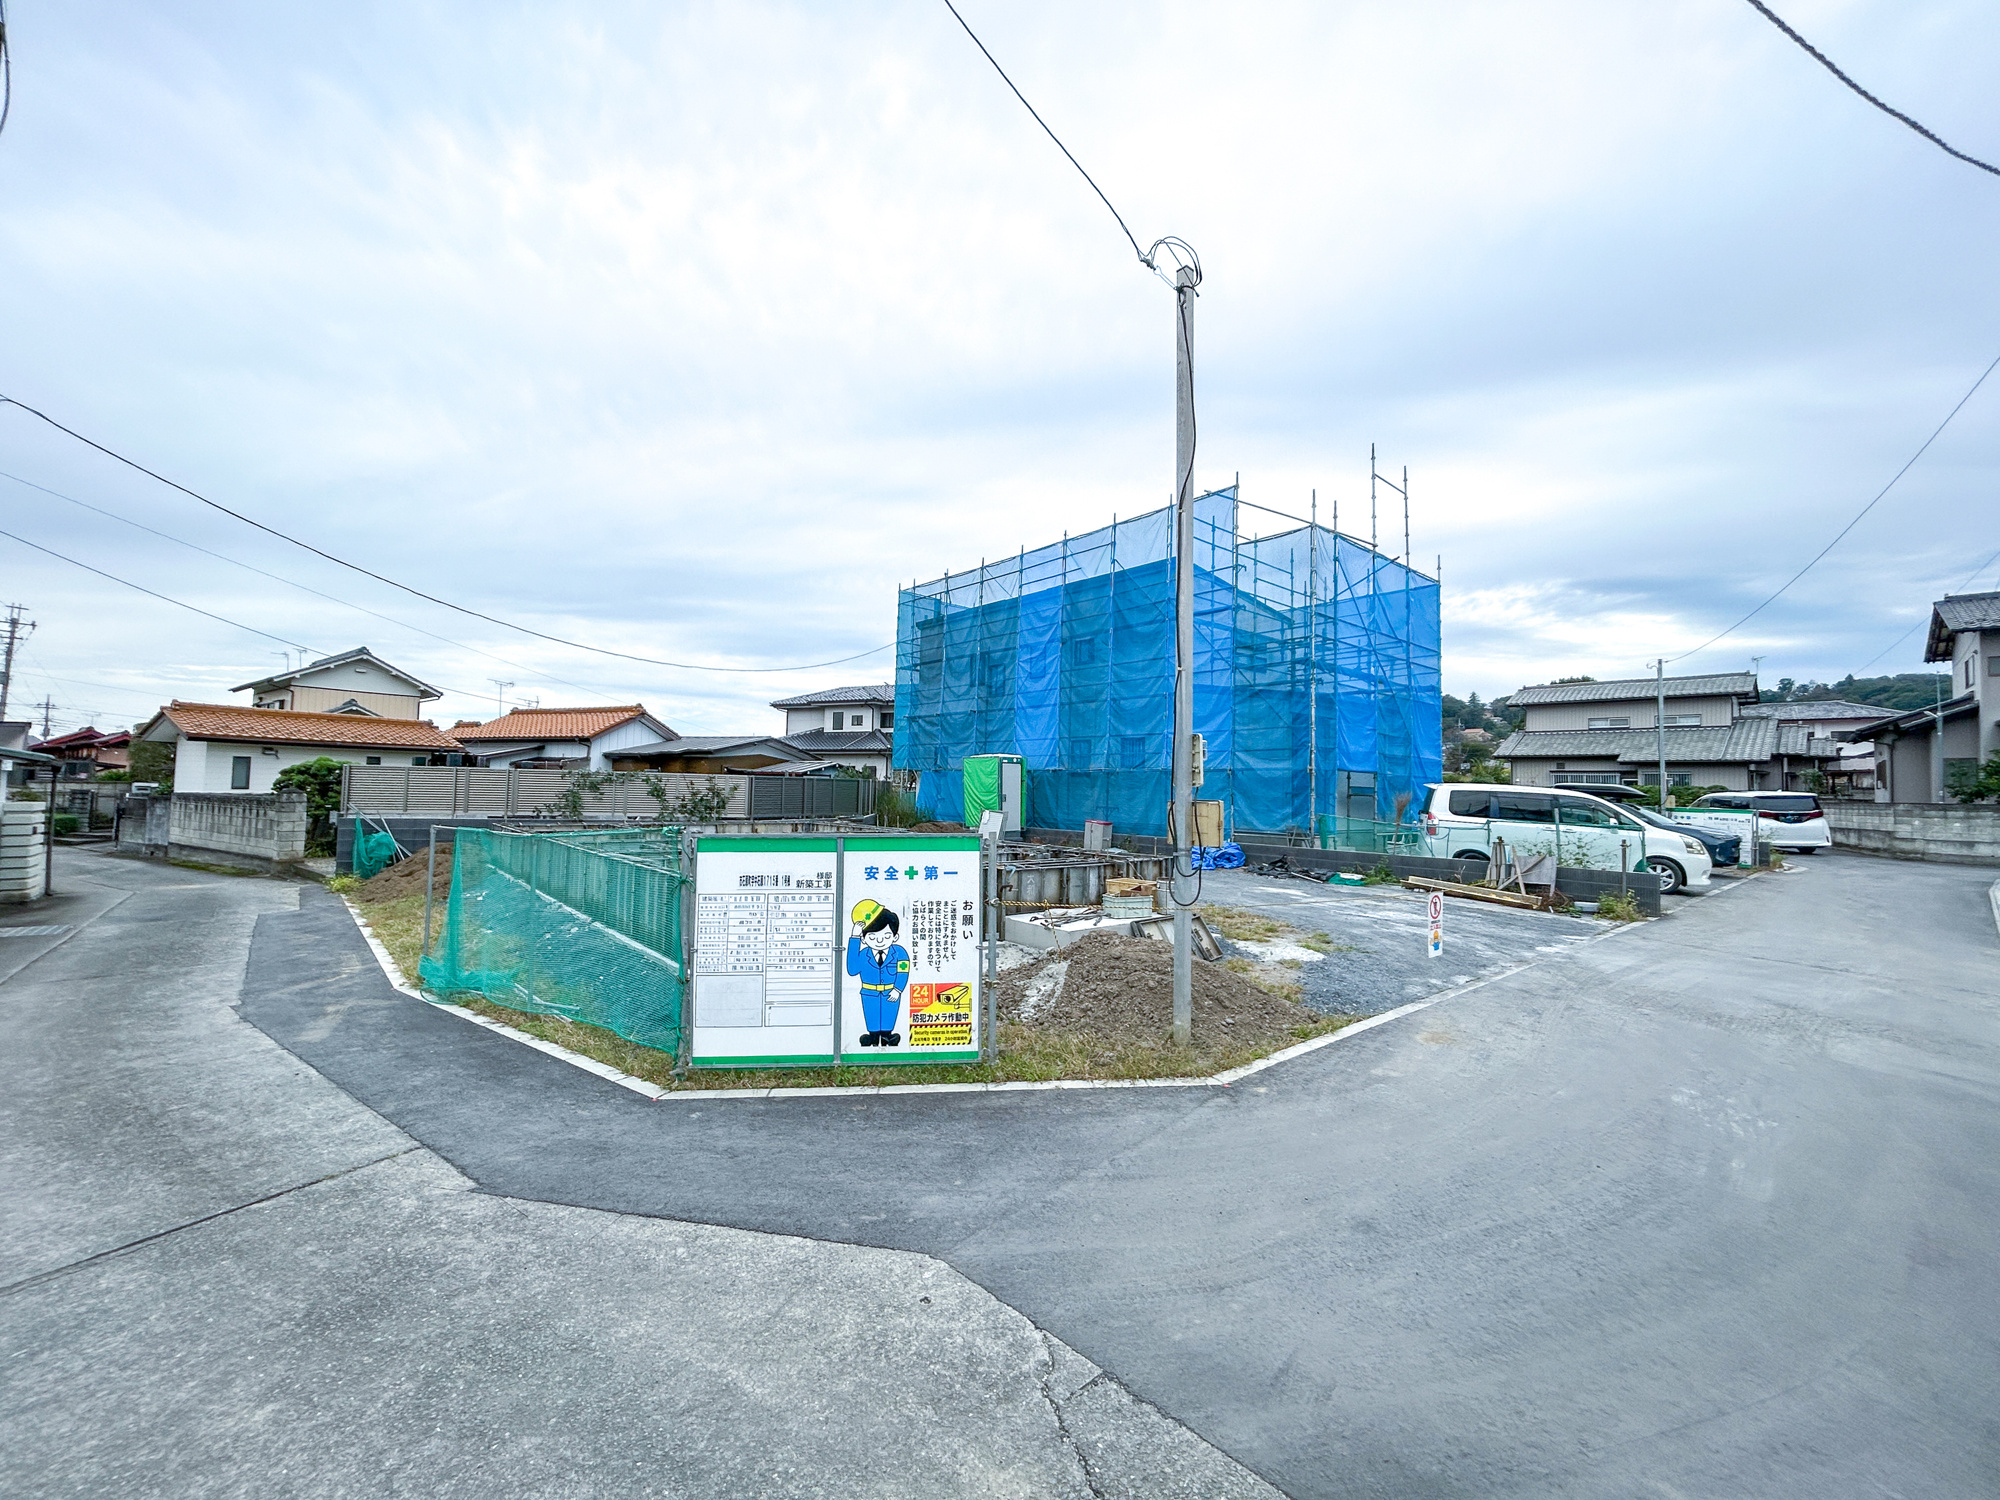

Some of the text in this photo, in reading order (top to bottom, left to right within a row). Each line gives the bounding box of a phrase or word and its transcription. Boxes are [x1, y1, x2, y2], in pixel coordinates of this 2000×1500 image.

[864, 865, 958, 880] 安全 第一
[796, 879, 832, 889] 新築工事
[962, 899, 974, 940] お願い
[913, 985, 929, 997] 24
[912, 1013, 969, 1022] 防犯カメラ作動中
